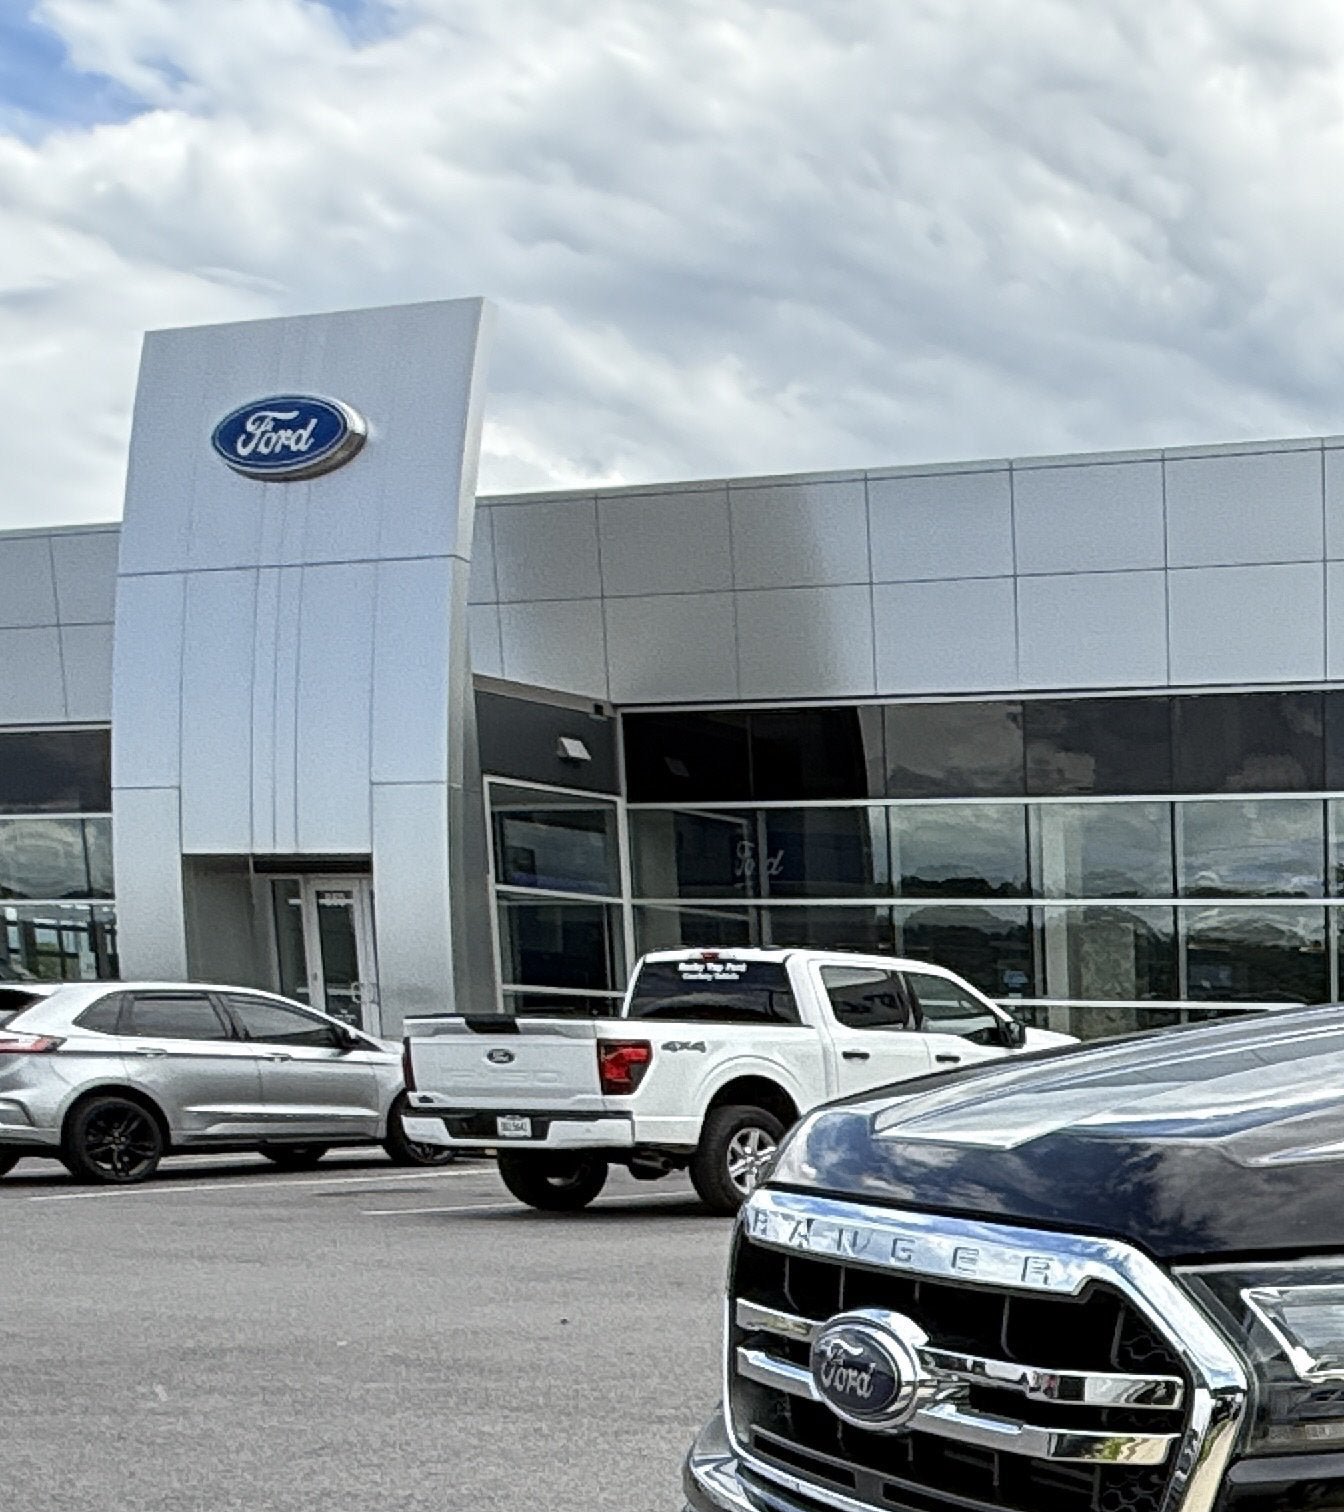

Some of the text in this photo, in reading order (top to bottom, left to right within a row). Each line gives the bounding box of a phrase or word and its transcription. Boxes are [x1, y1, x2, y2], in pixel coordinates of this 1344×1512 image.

[236, 410, 318, 456] Ford
[734, 840, 784, 876] Fod
[750, 1209, 1057, 1288] RANGER
[815, 1338, 876, 1399] Ford
